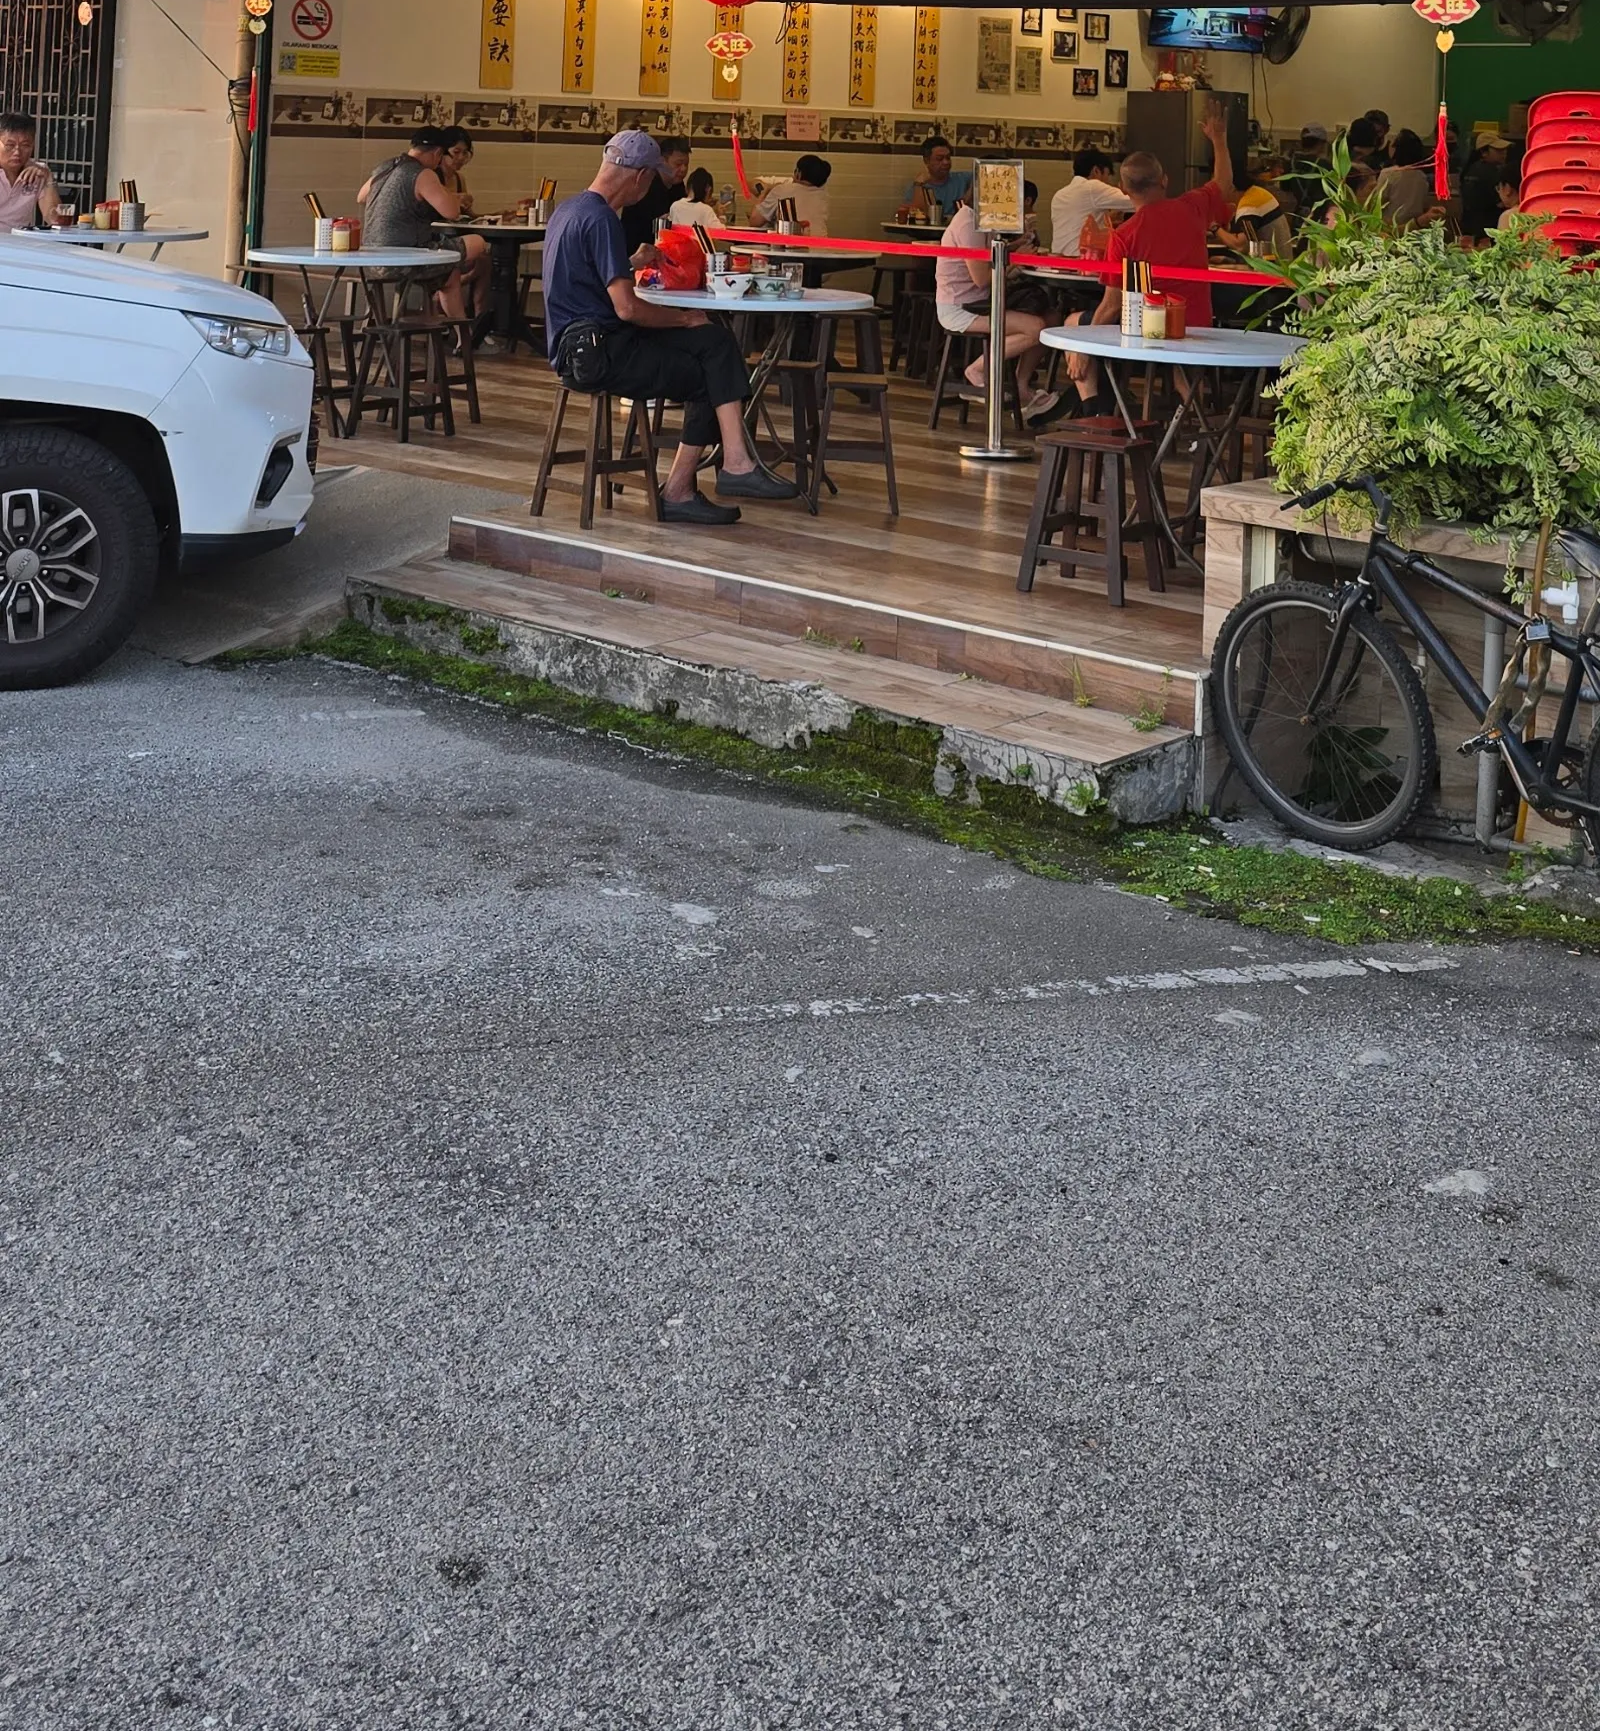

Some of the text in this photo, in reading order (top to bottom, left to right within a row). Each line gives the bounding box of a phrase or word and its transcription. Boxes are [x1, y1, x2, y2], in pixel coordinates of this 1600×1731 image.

[282, 41, 339, 51] DILARANG MEROKOK
[711, 37, 748, 53] 大旺
